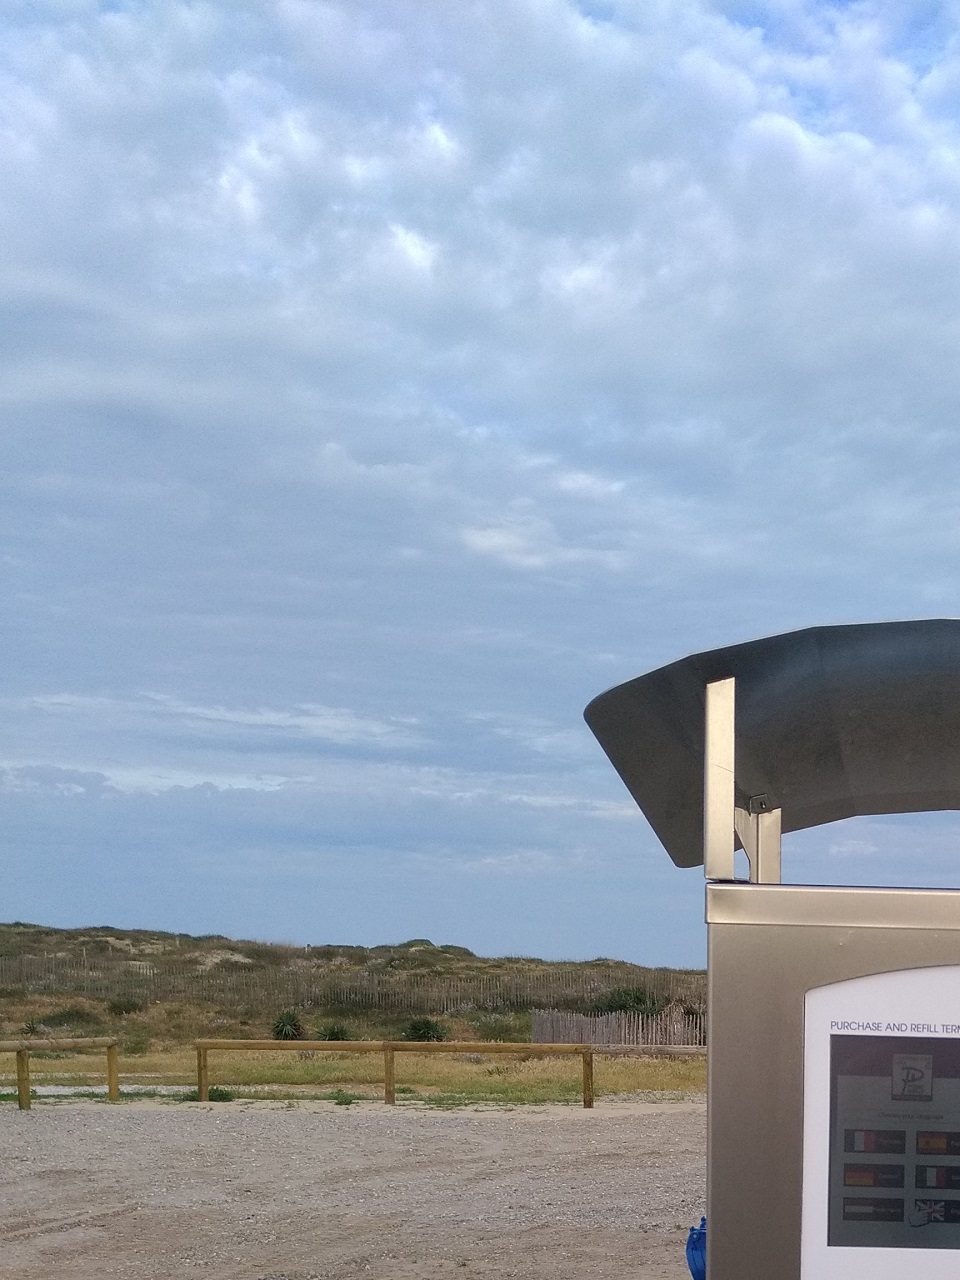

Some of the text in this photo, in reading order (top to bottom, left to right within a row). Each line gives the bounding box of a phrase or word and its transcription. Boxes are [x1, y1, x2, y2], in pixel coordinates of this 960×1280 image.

[830, 1020, 883, 1032] PURCHASE
[884, 1022, 908, 1032] AND
[910, 1023, 939, 1034] REFILL
